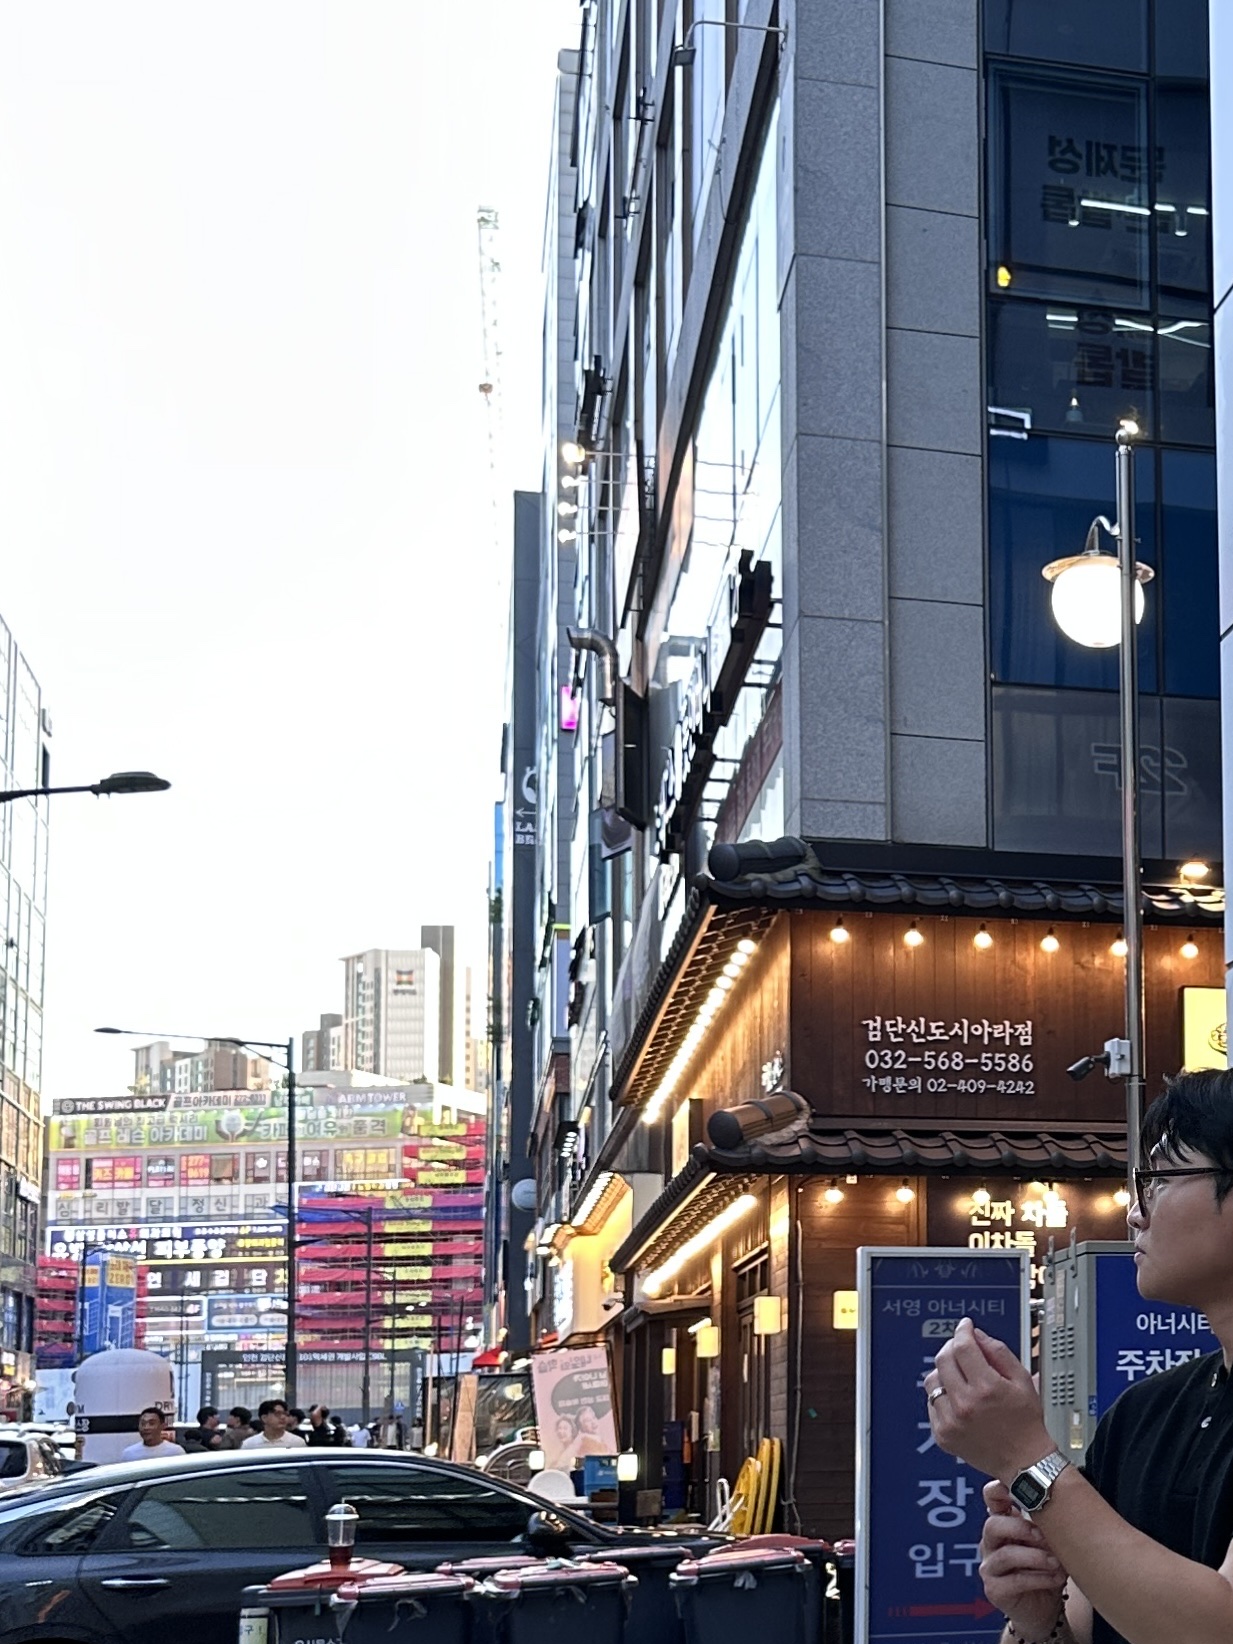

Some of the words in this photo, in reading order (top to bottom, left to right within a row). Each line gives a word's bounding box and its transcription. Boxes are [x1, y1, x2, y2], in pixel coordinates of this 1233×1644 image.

[861, 1016, 1033, 1046] 검단신도시아라점
[865, 1050, 1034, 1073] 032-568-5586
[862, 1075, 922, 1094] 가맹문의
[926, 1078, 1035, 1095] 02-409-4242
[75, 1100, 97, 1111] THE
[98, 1098, 132, 1110] SWING
[133, 1097, 166, 1110] BLACK
[150, 1125, 208, 1142] 아카데미
[882, 1299, 921, 1317] 서영
[928, 1298, 1006, 1316] 아너시티
[908, 1542, 983, 1579] 입구
